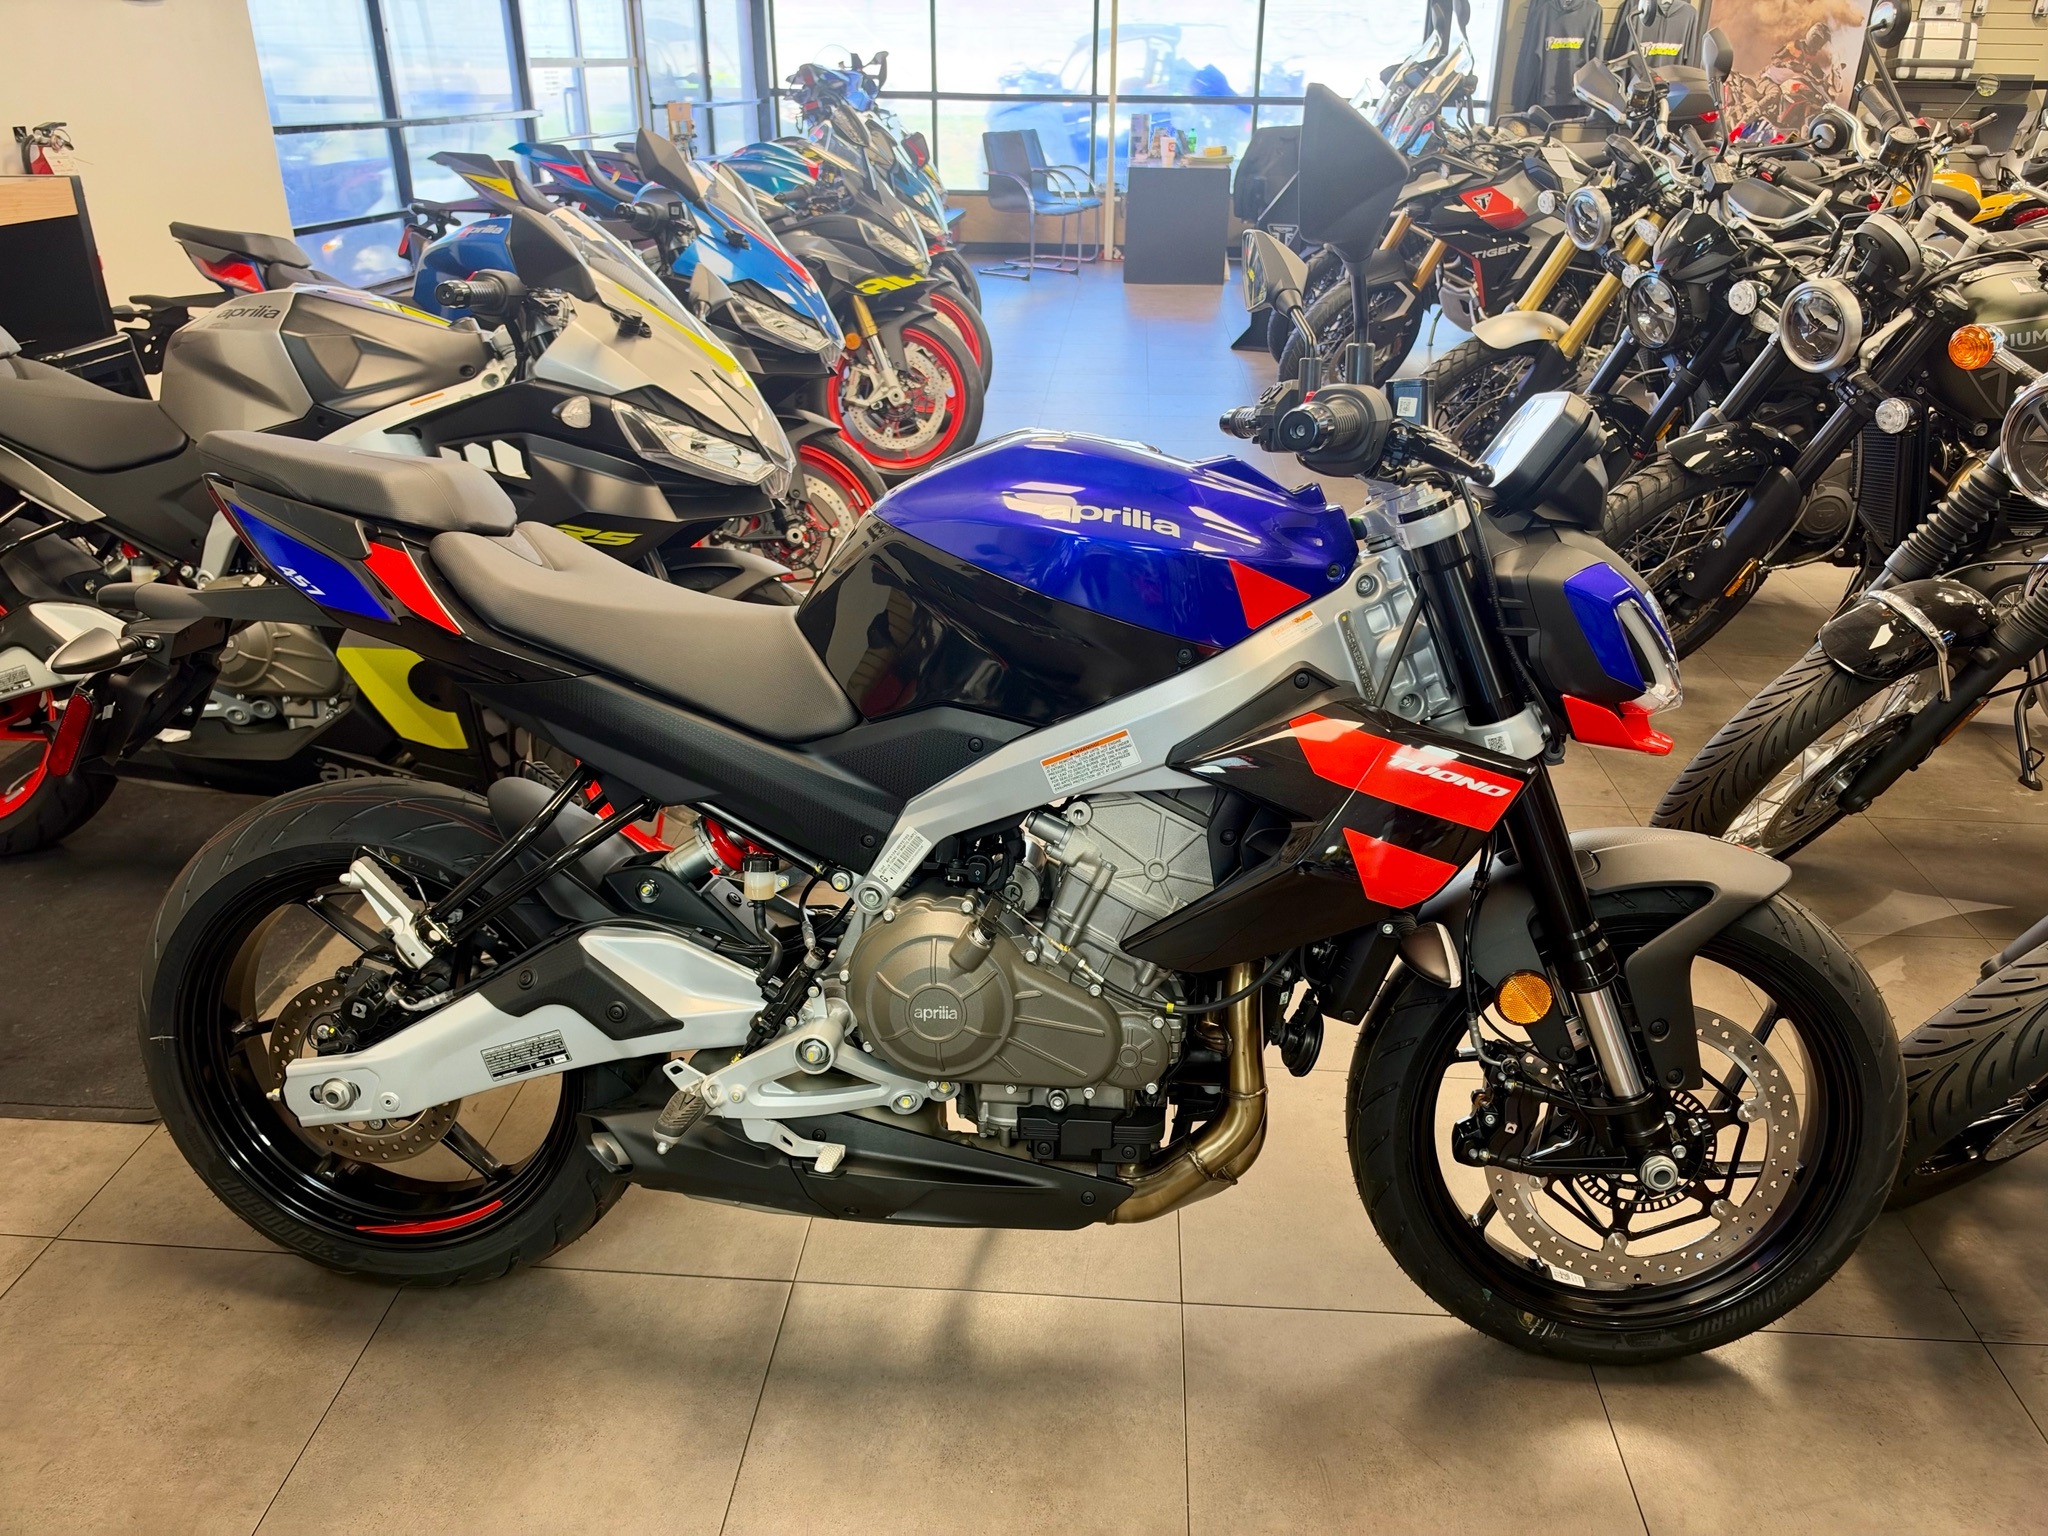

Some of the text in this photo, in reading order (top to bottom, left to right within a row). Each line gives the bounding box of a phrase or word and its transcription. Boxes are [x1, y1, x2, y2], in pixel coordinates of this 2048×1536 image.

[1472, 243, 1520, 259] TIGER
[216, 305, 281, 320] aprilia
[1041, 504, 1181, 538] aprilia
[277, 565, 327, 596] 457
[1389, 755, 1511, 797] TUONO
[914, 1006, 957, 1021] aprilia
